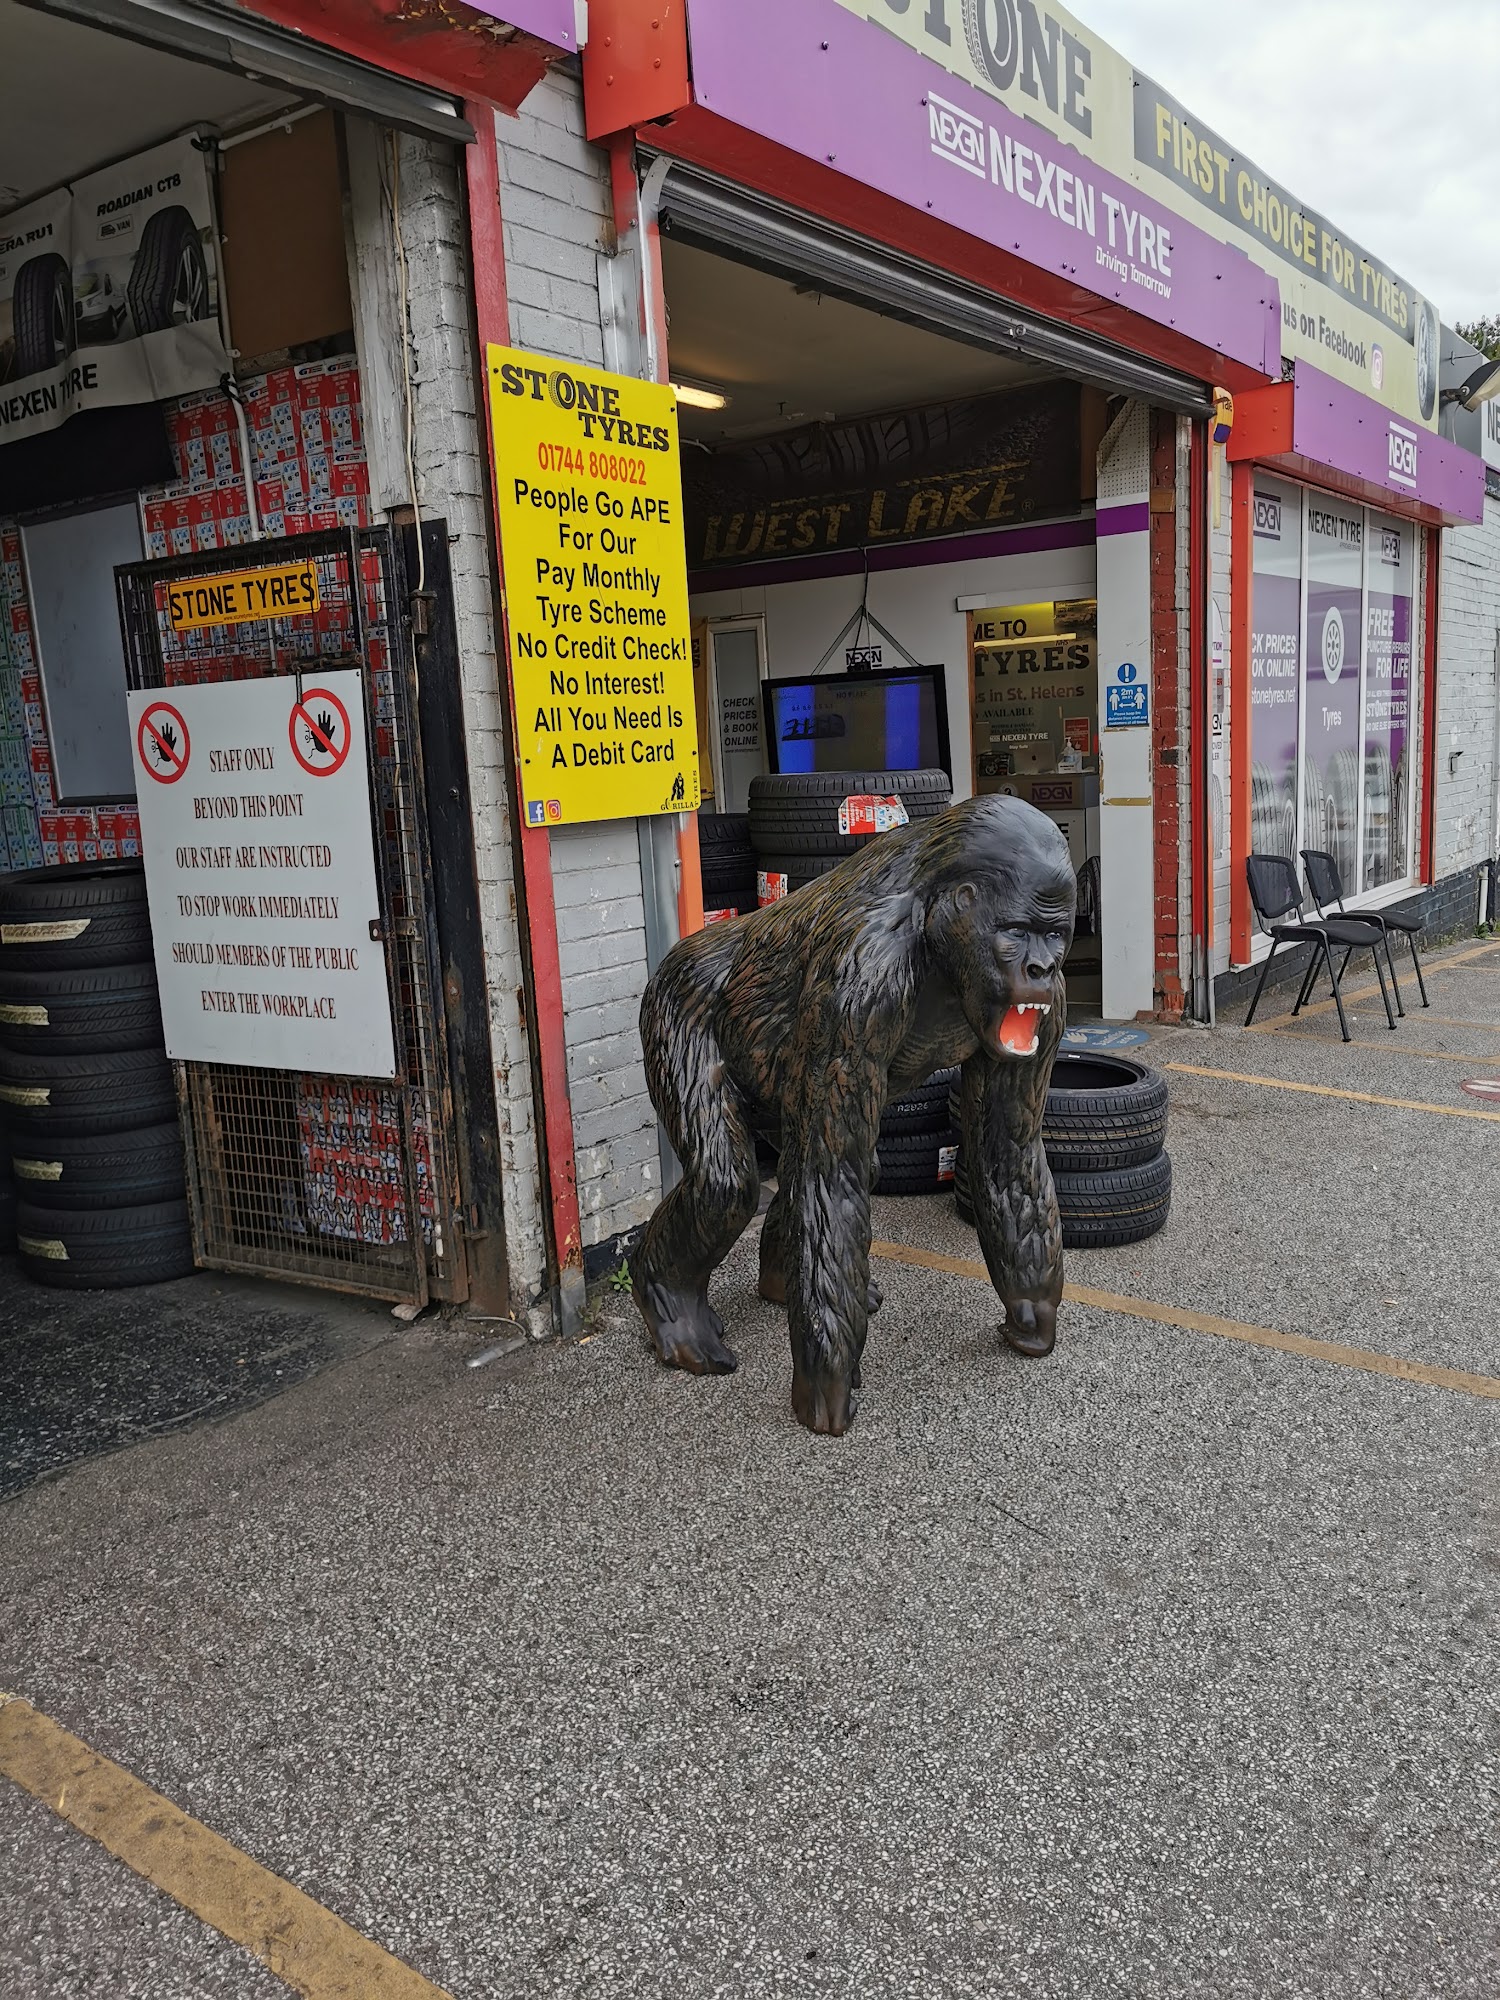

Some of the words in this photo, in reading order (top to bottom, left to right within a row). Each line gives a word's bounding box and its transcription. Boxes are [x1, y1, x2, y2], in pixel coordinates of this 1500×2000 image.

[928, 104, 986, 167] NEXEN
[96, 185, 153, 216] ROADIAN
[157, 174, 182, 193] CT8
[989, 125, 1096, 237] NEXEN
[1102, 192, 1172, 278] TYRE
[117, 220, 131, 231] VAN
[1156, 102, 1229, 204] FIRST
[1238, 170, 1317, 268] CHOICE
[1322, 230, 1356, 294] FOR
[1360, 259, 1408, 329] TYRES
[26, 223, 52, 243] RU1
[1096, 245, 1127, 283] Driving
[1130, 263, 1172, 299] Tomorrow
[1283, 302, 1297, 327] us
[1301, 314, 1316, 339] on
[1319, 316, 1366, 370] Facebook
[0, 385, 57, 426] NEXEN
[60, 364, 98, 406] TYRE
[502, 364, 620, 417] STONE
[578, 412, 669, 452] TYRES
[538, 442, 584, 476] 01744
[590, 451, 646, 486] 808022
[1388, 433, 1416, 476] NEXEN
[514, 479, 588, 517] People
[596, 491, 624, 518] Go
[630, 496, 670, 524] APE
[702, 503, 851, 561] WEST
[868, 474, 1024, 538] LAKE
[1308, 508, 1337, 538] NEXEN
[1339, 518, 1361, 543] TYRE
[559, 523, 594, 550] For
[600, 528, 636, 554] Our
[1382, 534, 1400, 559] NEXEN
[536, 558, 575, 592] Pay
[583, 562, 660, 598] Monthly
[171, 584, 237, 620] STONE
[242, 573, 314, 610] TYRES
[536, 596, 582, 628] Tyre
[590, 599, 666, 626] Scheme
[1368, 608, 1394, 636] FREE
[1000, 618, 1026, 637] TO
[518, 632, 548, 658] No
[555, 634, 616, 660] Credit
[624, 636, 686, 660] Check!
[1265, 634, 1296, 654] PRICES
[1266, 659, 1296, 677] ONLINE
[1376, 658, 1391, 678] FOR
[1393, 658, 1409, 678] LIFE
[550, 670, 578, 695] No
[586, 670, 665, 694] Interest!
[990, 689, 1002, 702] in
[1007, 688, 1026, 700] St.
[1032, 686, 1084, 699] Helens
[1121, 688, 1133, 696] 2m
[724, 697, 755, 708] CHECK
[724, 710, 756, 722] PRICES
[984, 708, 1034, 718] AVAILABLE
[534, 708, 562, 732] All
[568, 706, 606, 730] You
[614, 706, 662, 729] Need
[668, 706, 682, 728] Is
[724, 725, 730, 733] &
[732, 722, 758, 732] BOOK
[1322, 707, 1341, 731] Tyres
[724, 736, 758, 746] ONLINE
[1002, 734, 1026, 742] NEXEN
[1030, 732, 1048, 740] TYRE
[210, 750, 242, 772] STAFF
[244, 747, 274, 770] ONLY
[552, 744, 567, 768] A
[573, 742, 625, 766] Debit
[632, 739, 674, 763] Card
[194, 797, 238, 819] BEYOND
[240, 796, 266, 818] THIS
[268, 794, 304, 816] POINT
[1032, 786, 1072, 800] NEXEN
[176, 847, 199, 868] OUR
[200, 847, 232, 868] STAFF
[235, 846, 256, 868] ARE
[258, 846, 332, 868] INSTRUCTED
[178, 896, 192, 916] TO
[194, 896, 220, 917] STOP
[222, 896, 258, 918] WORK
[258, 896, 338, 919] IMMEDIATELY
[172, 942, 214, 964] SHOULD
[216, 944, 270, 967] MEMBERS
[272, 946, 286, 968] OF
[288, 946, 313, 969] THE
[315, 948, 359, 970] PUBLIC
[202, 990, 237, 1013] ENTER
[238, 992, 260, 1014] THE
[262, 994, 336, 1019] WORKPLACE
